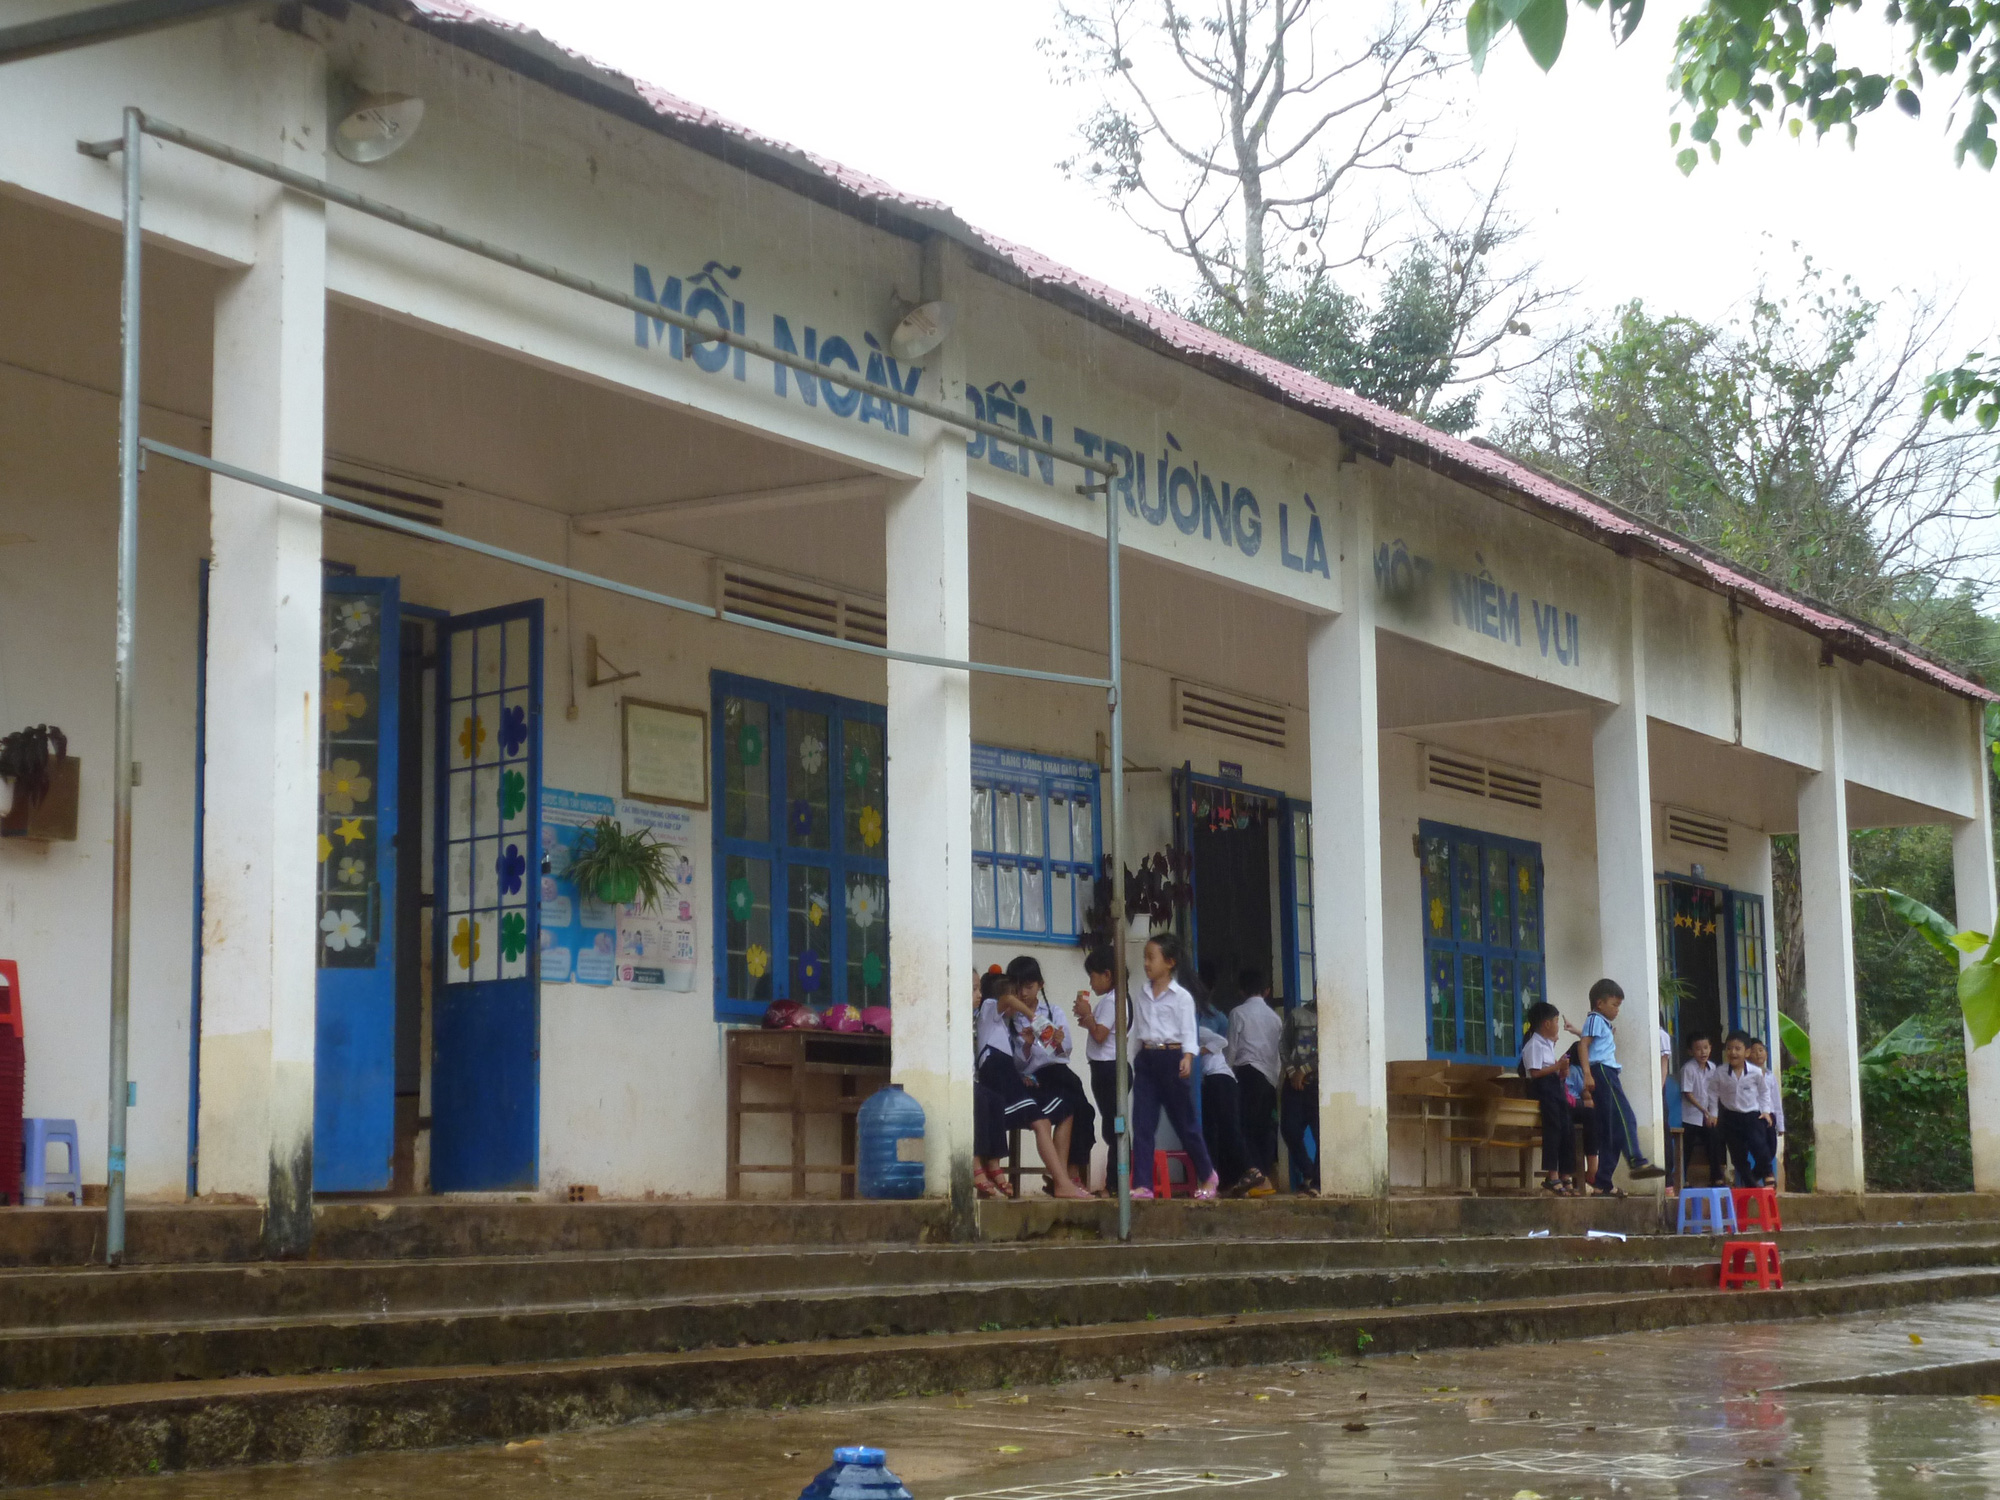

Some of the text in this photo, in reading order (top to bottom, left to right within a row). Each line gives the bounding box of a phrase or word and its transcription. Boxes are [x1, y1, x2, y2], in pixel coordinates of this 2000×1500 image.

[634, 260, 922, 436] MỖI NGÀY
[1074, 427, 1262, 557] TRƯỜNG
[1279, 492, 1331, 580] LÀ
[1451, 551, 1521, 648] NIỀM
[1532, 598, 1580, 667] VUI
